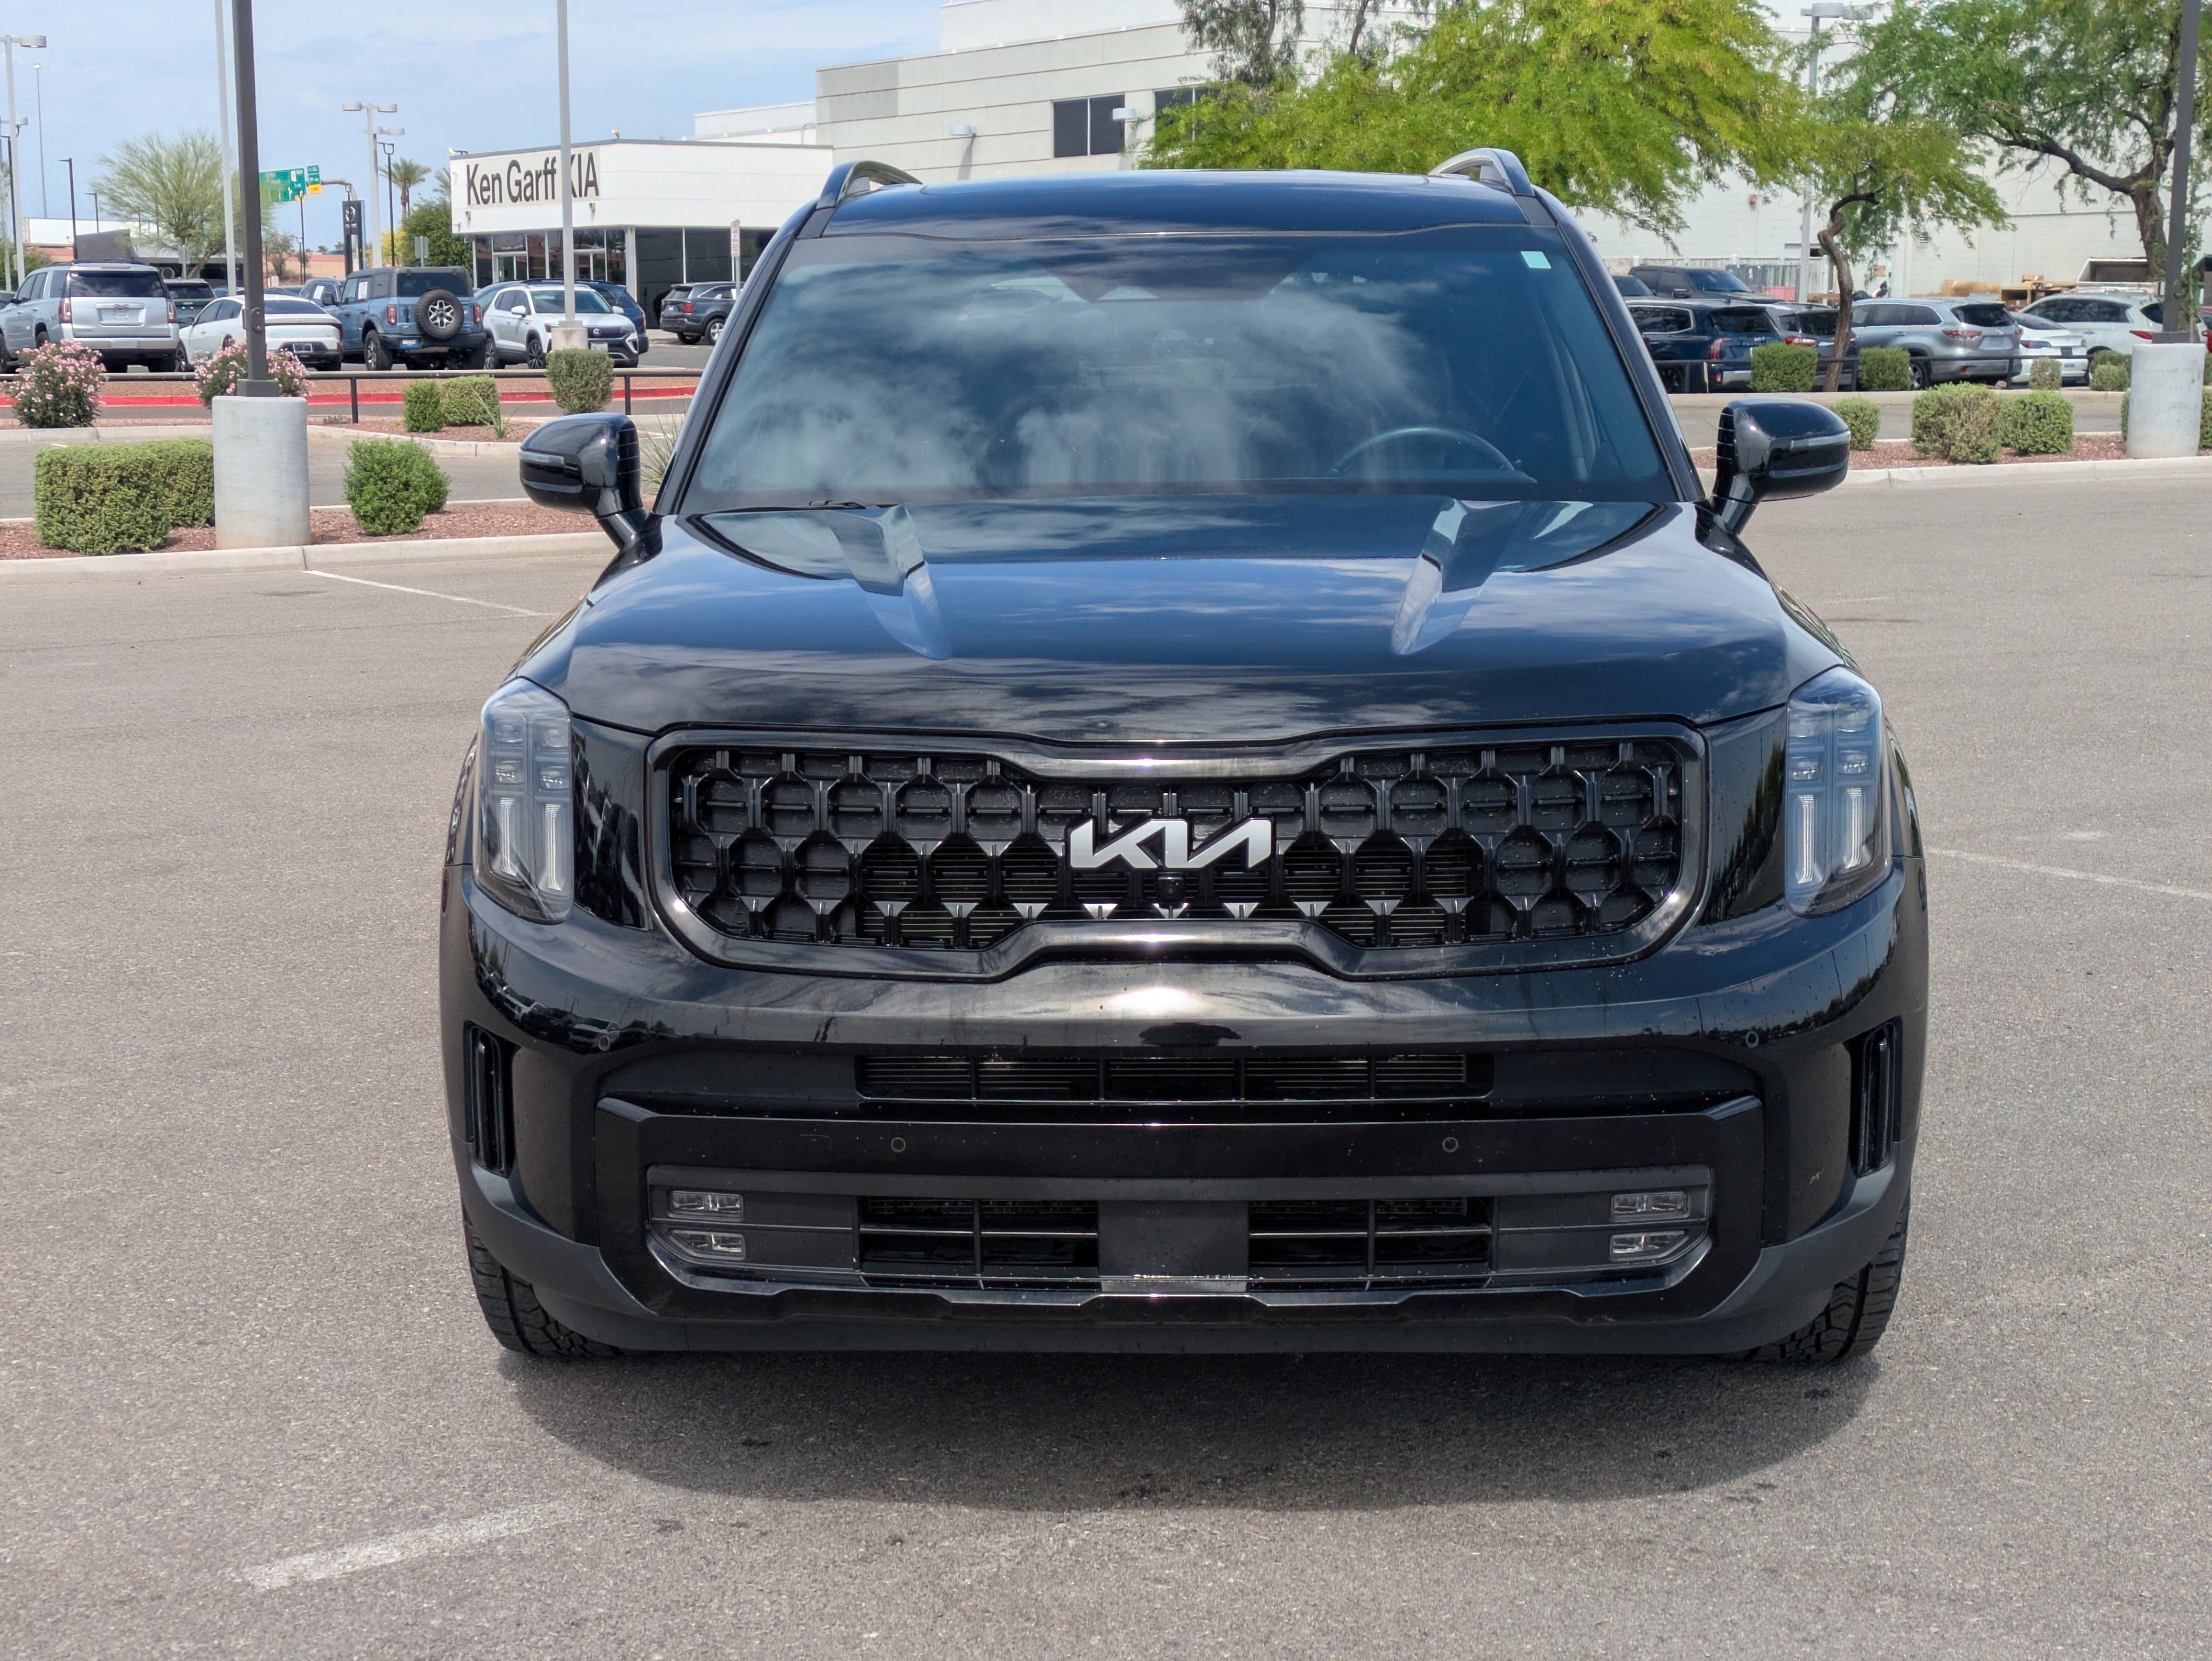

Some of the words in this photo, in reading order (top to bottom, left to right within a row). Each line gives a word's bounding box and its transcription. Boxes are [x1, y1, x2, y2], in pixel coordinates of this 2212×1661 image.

[466, 164, 502, 205] Ken
[507, 156, 556, 203] Garff
[1070, 818, 1272, 868] KIA
